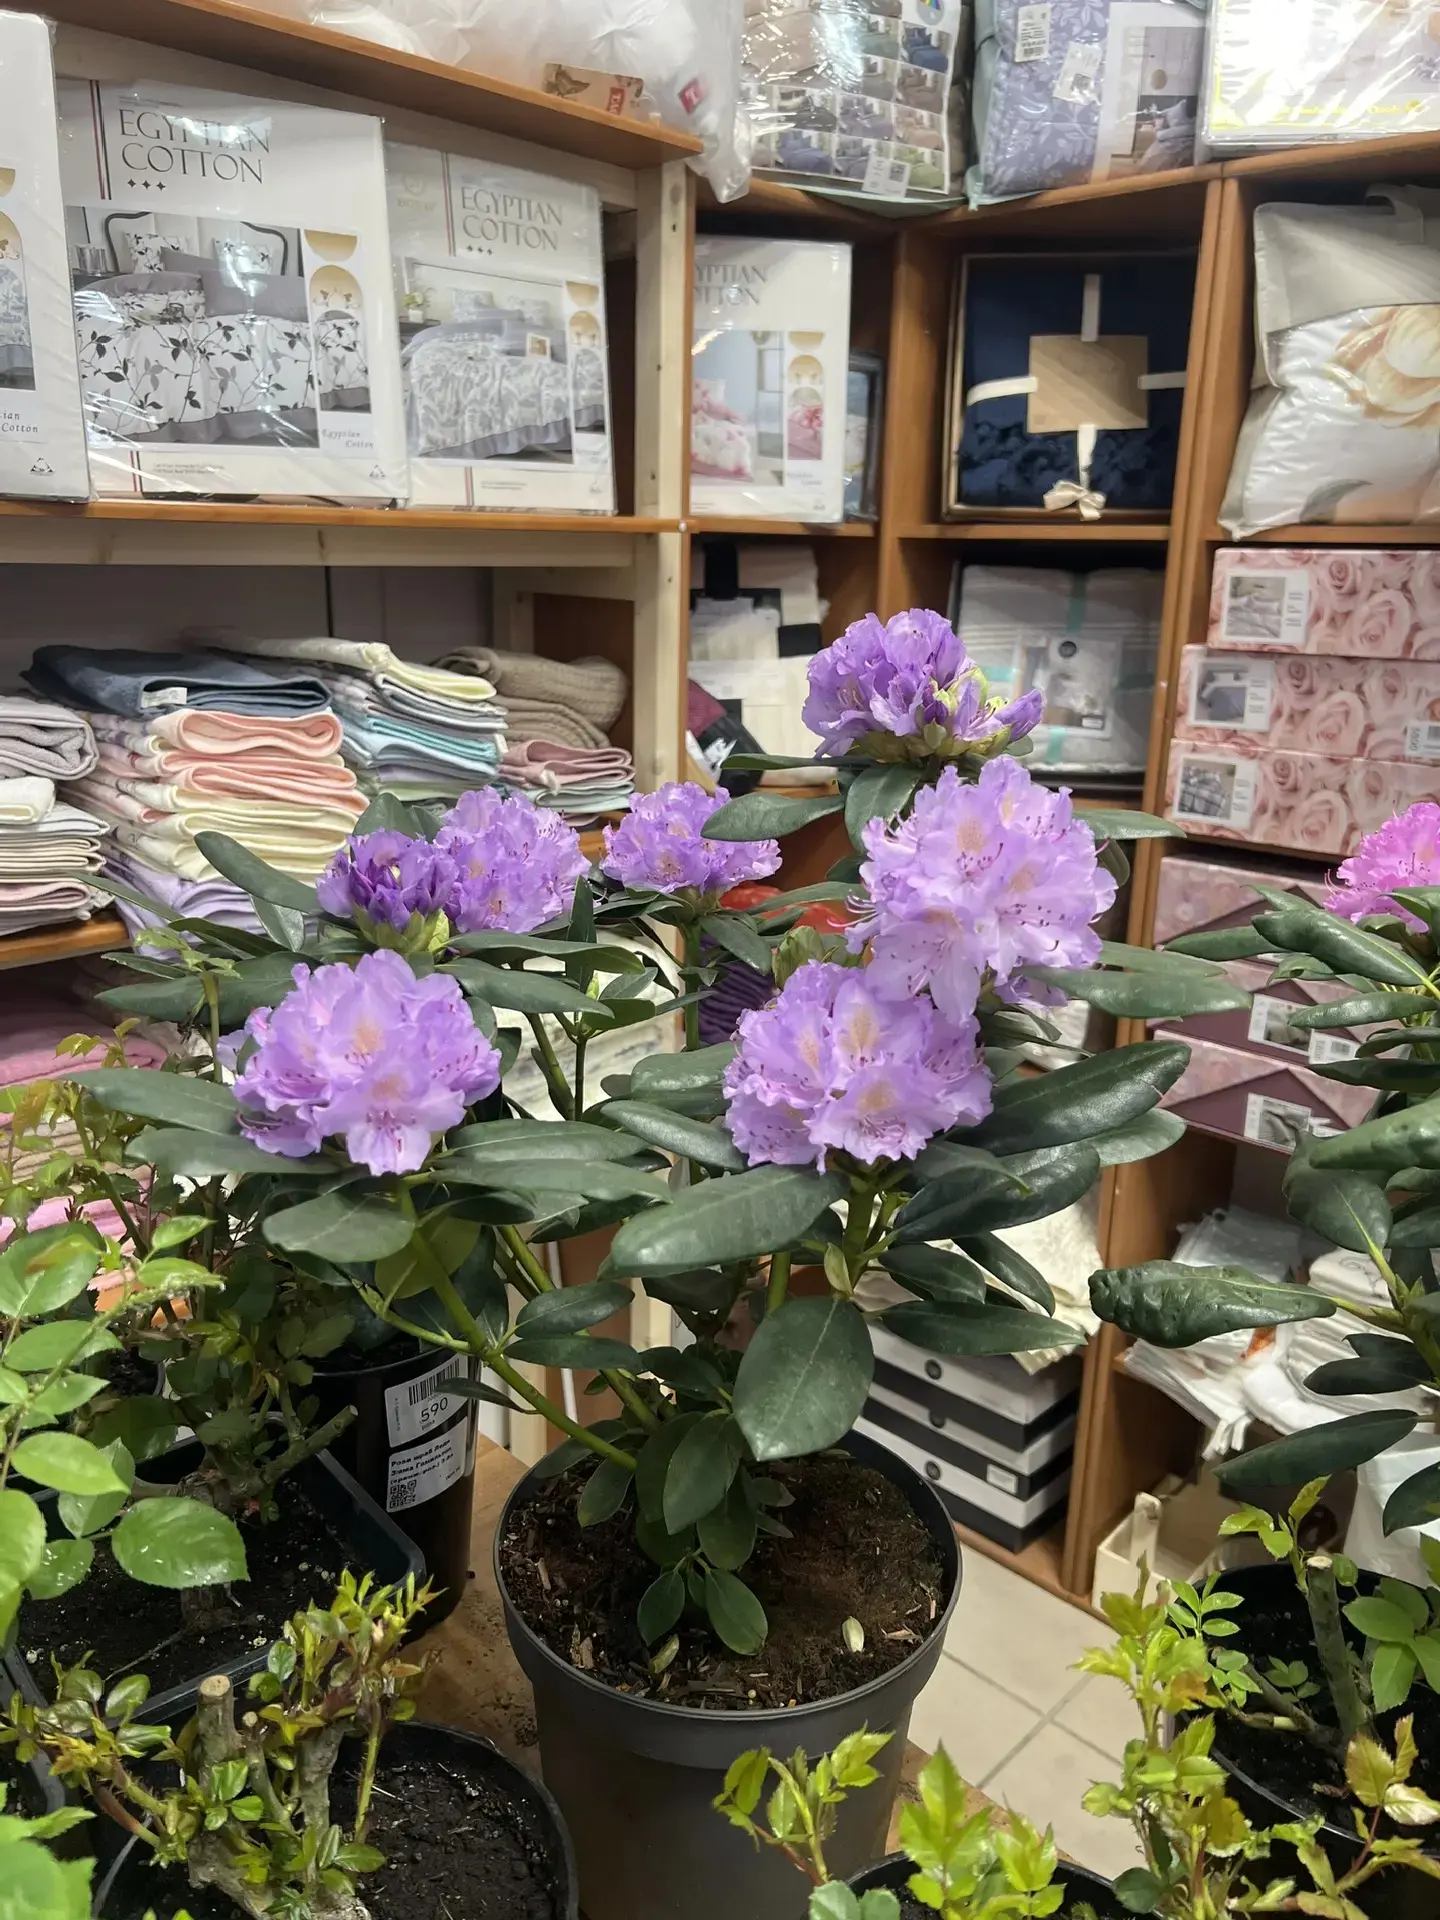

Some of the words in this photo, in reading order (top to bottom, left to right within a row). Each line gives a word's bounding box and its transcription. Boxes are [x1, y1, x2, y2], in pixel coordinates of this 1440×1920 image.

[122, 142, 263, 184] COTTON
[461, 186, 563, 226] EGYPTIAN
[463, 214, 558, 250] COTTON
[1, 422, 38, 432] Cotton
[421, 1397, 448, 1422] 590
